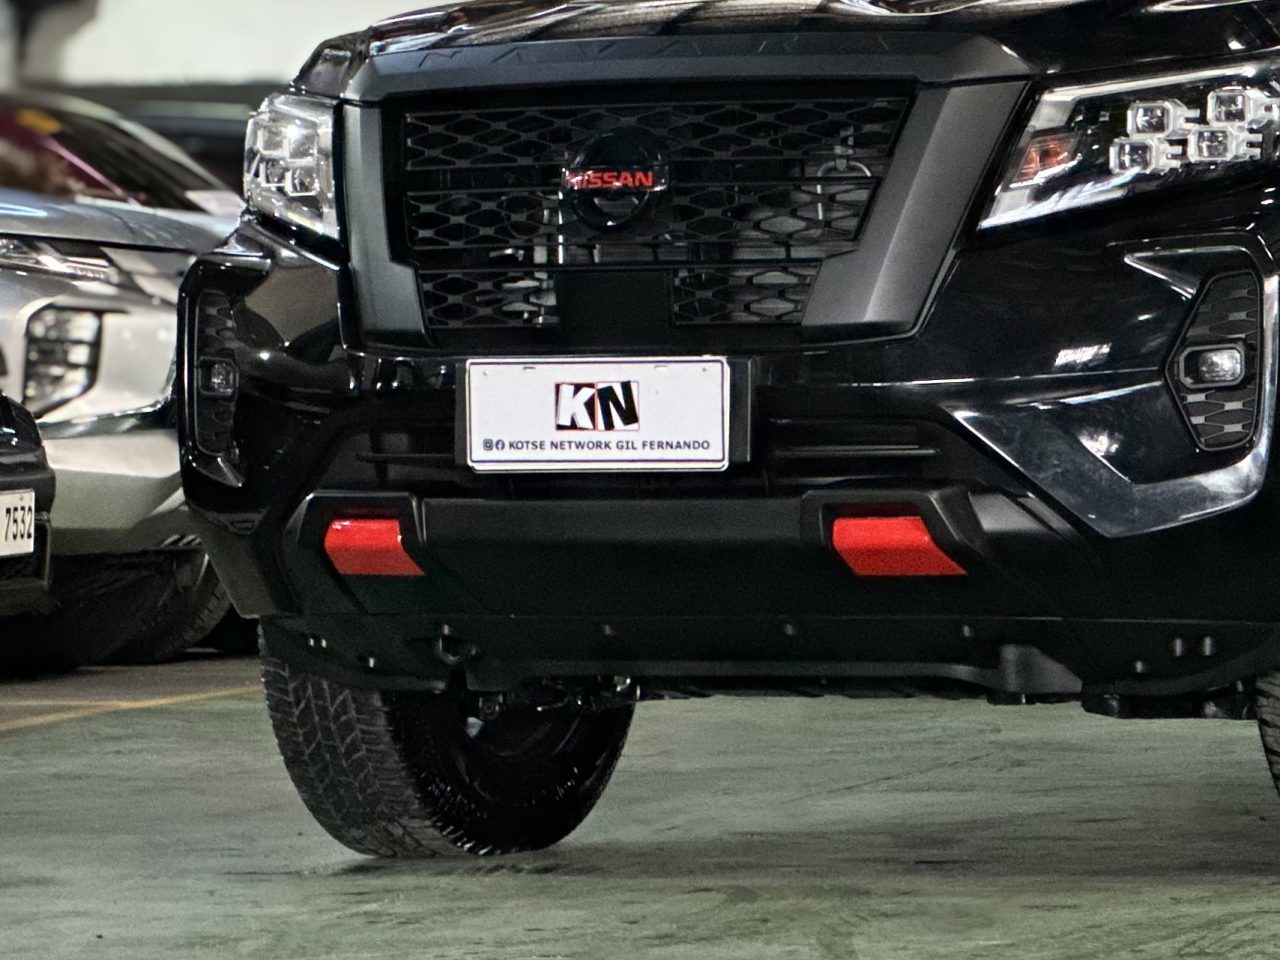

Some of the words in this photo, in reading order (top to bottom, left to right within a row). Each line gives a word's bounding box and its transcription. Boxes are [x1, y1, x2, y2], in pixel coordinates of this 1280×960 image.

[566, 170, 654, 189] NISSAN
[555, 380, 640, 431] KN
[508, 440, 547, 451] KOTSE
[550, 440, 612, 451] NETWORK
[616, 440, 638, 450] GIL
[642, 440, 710, 451] FERNANDO
[4, 505, 33, 542] 7532
